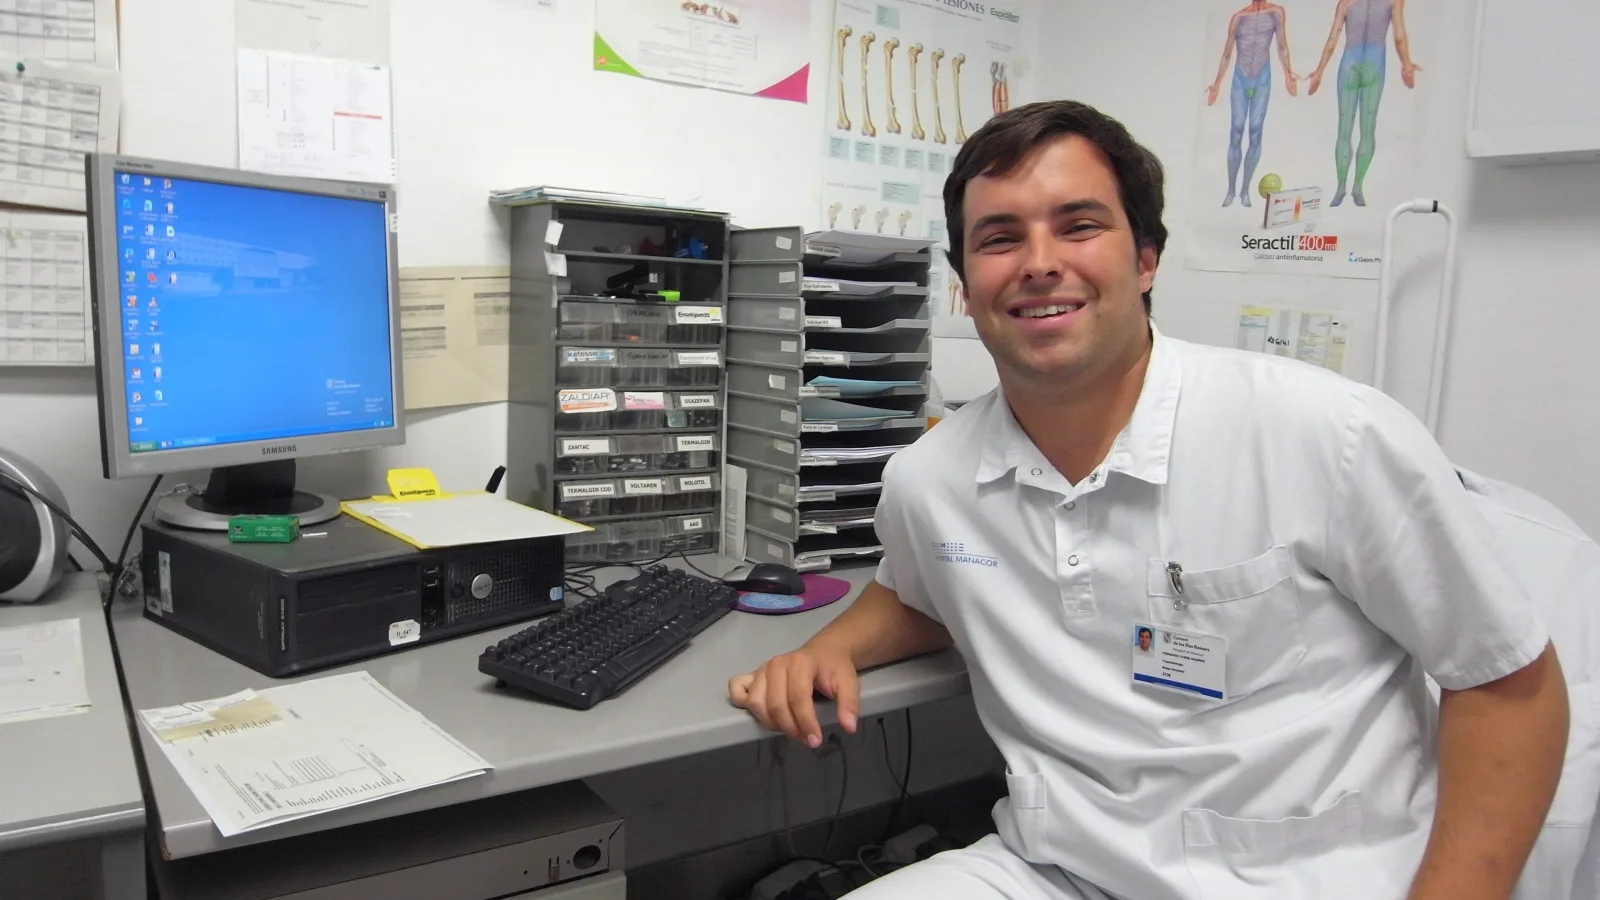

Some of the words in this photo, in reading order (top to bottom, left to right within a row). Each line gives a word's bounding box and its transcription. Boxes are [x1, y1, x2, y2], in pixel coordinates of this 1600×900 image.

[990, 7, 1020, 23] Espidifen
[1241, 234, 1295, 250] Seractil
[1299, 236, 1324, 250] 400
[560, 392, 611, 401] ZALDIAR
[262, 444, 297, 455] SAMSUNG
[956, 556, 998, 567] MANACOR
